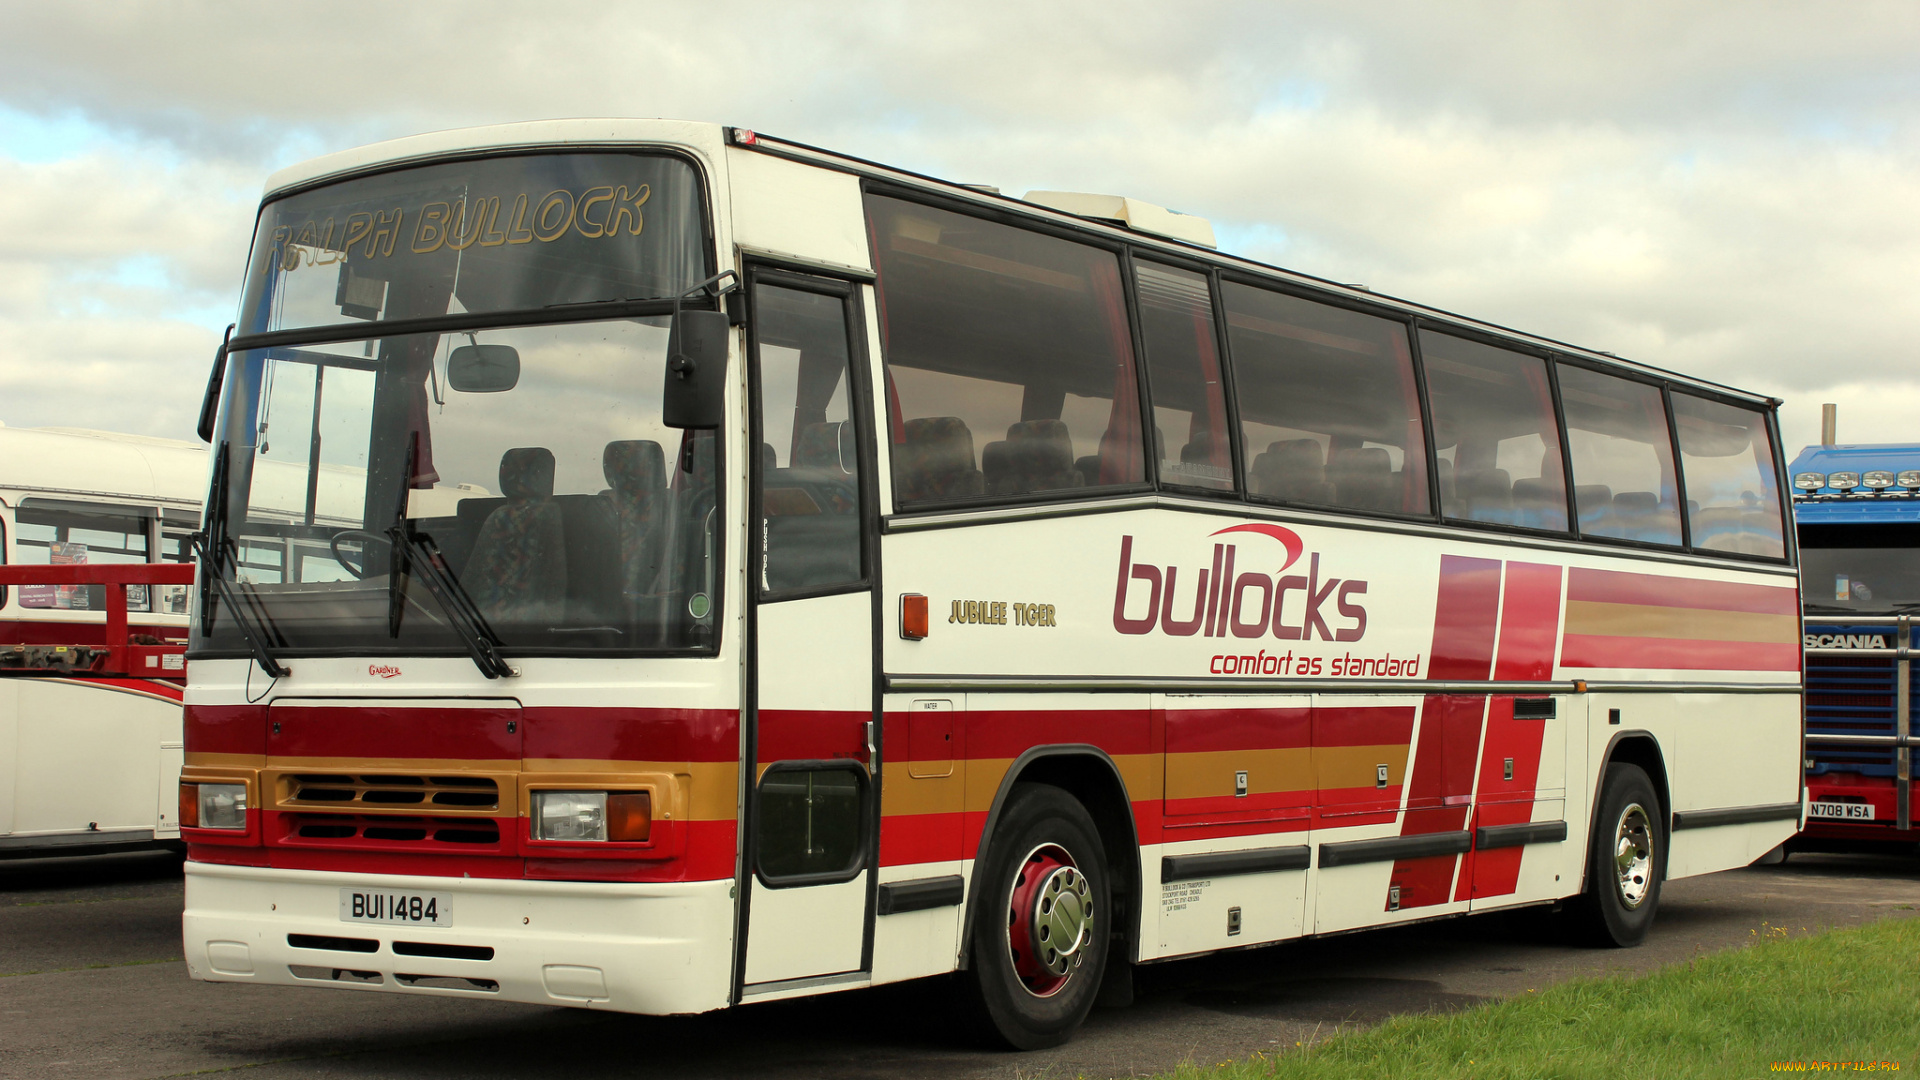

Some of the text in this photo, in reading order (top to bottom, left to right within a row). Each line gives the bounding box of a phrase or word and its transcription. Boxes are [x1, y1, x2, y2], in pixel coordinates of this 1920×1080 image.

[261, 183, 651, 275] RALPH BULLOCK
[1113, 535, 1368, 642] bullocks
[948, 599, 1057, 627] JUBILEE TIGER
[1804, 634, 1887, 648] SCANIA
[368, 664, 402, 678] GARDNER
[1209, 649, 1420, 677] comfort as standard
[1811, 804, 1870, 818] N708 WSA
[352, 893, 438, 922] BUI 1484
